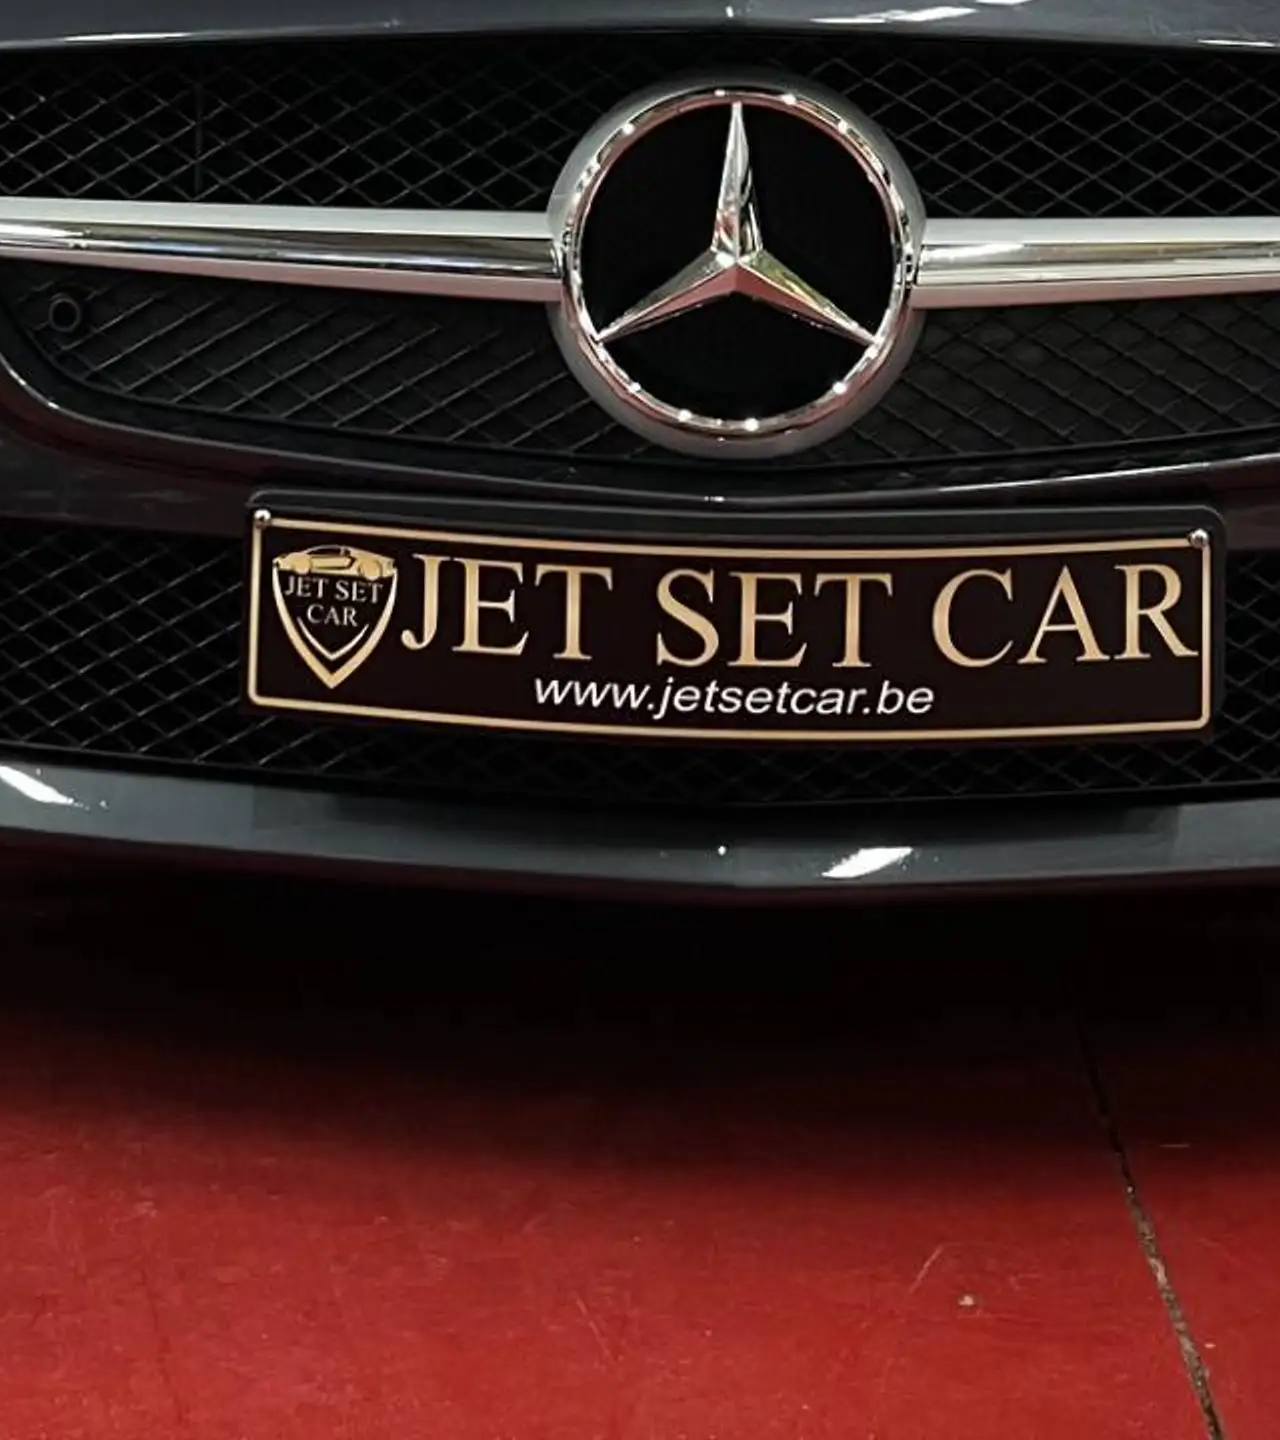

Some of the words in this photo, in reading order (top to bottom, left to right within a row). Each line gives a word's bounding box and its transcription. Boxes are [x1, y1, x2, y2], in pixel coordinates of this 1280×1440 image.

[285, 576, 329, 599] JET
[335, 580, 384, 604] SET
[307, 603, 358, 627] CAR
[400, 553, 613, 661] JET
[656, 568, 894, 668] SET
[931, 563, 1200, 668] CAR
[534, 676, 935, 720] www.jetsetcar.be
